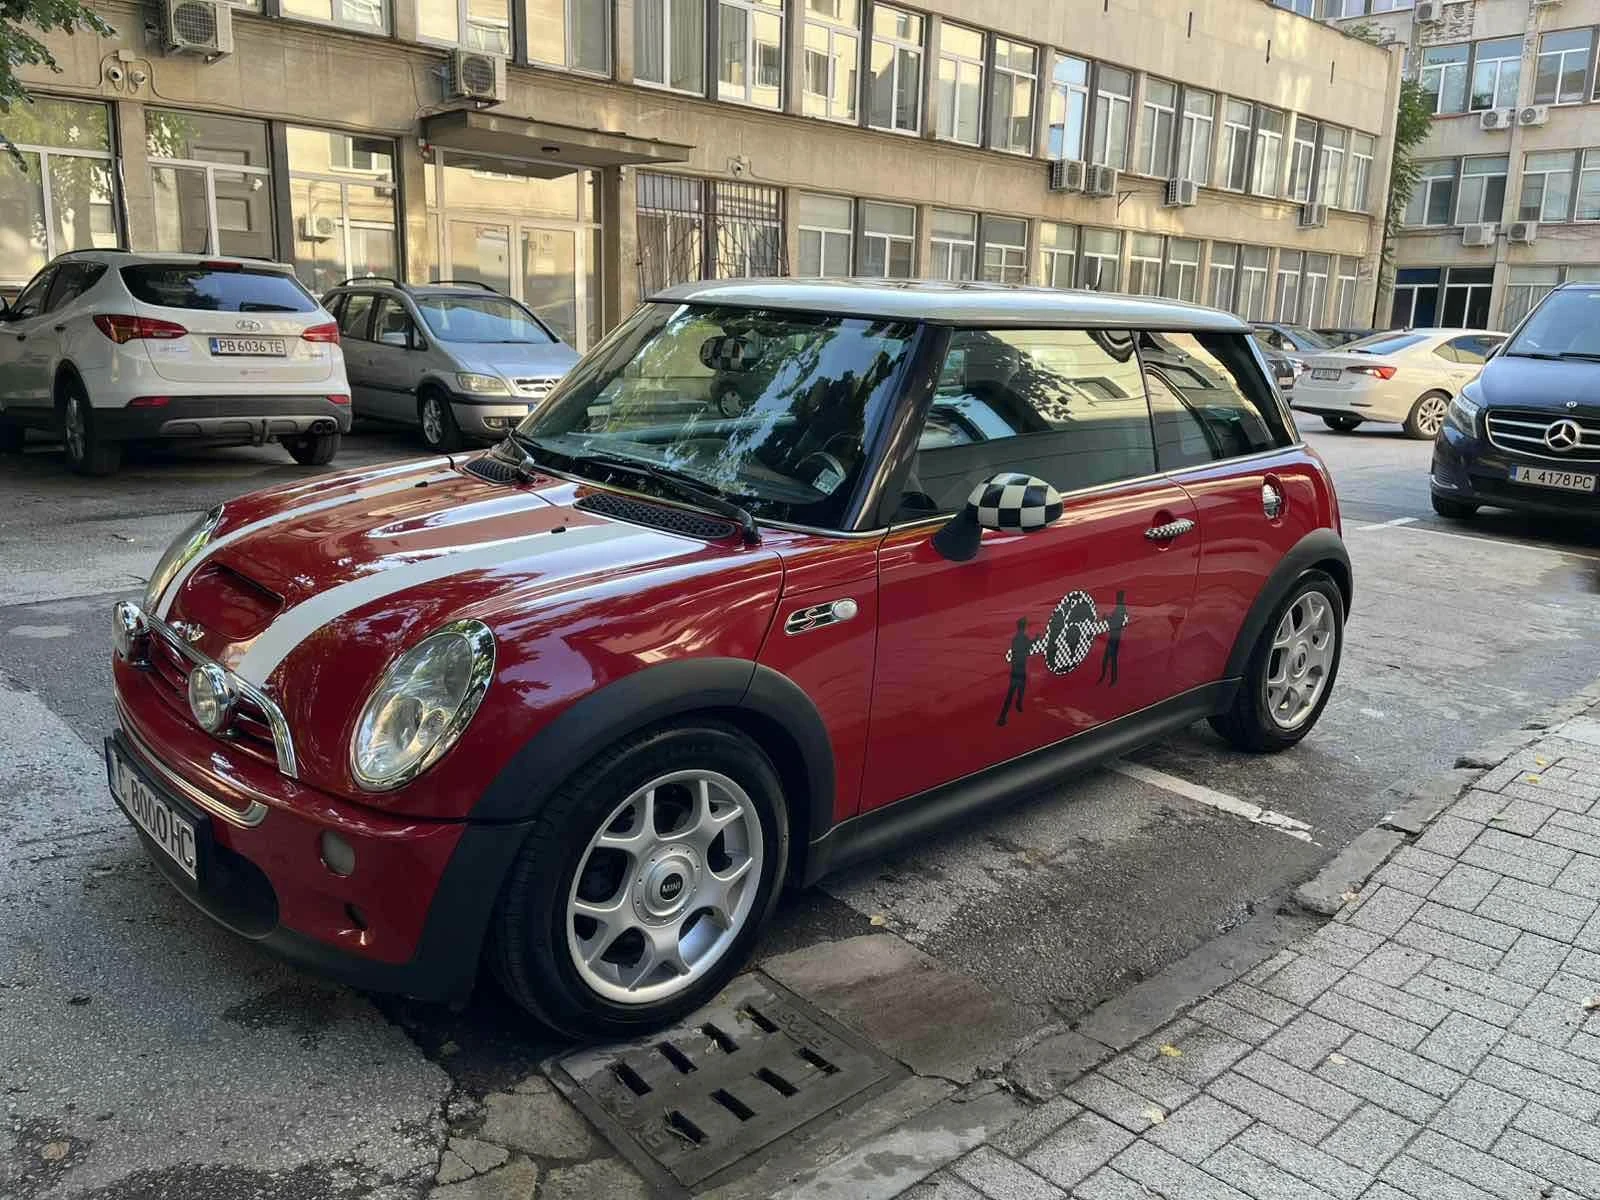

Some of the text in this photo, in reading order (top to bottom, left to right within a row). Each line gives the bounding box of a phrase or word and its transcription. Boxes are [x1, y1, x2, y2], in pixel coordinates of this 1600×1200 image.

[219, 340, 284, 353] PB 6036 TE
[1521, 469, 1594, 489] A 4178 PC
[169, 810, 194, 868] HC
